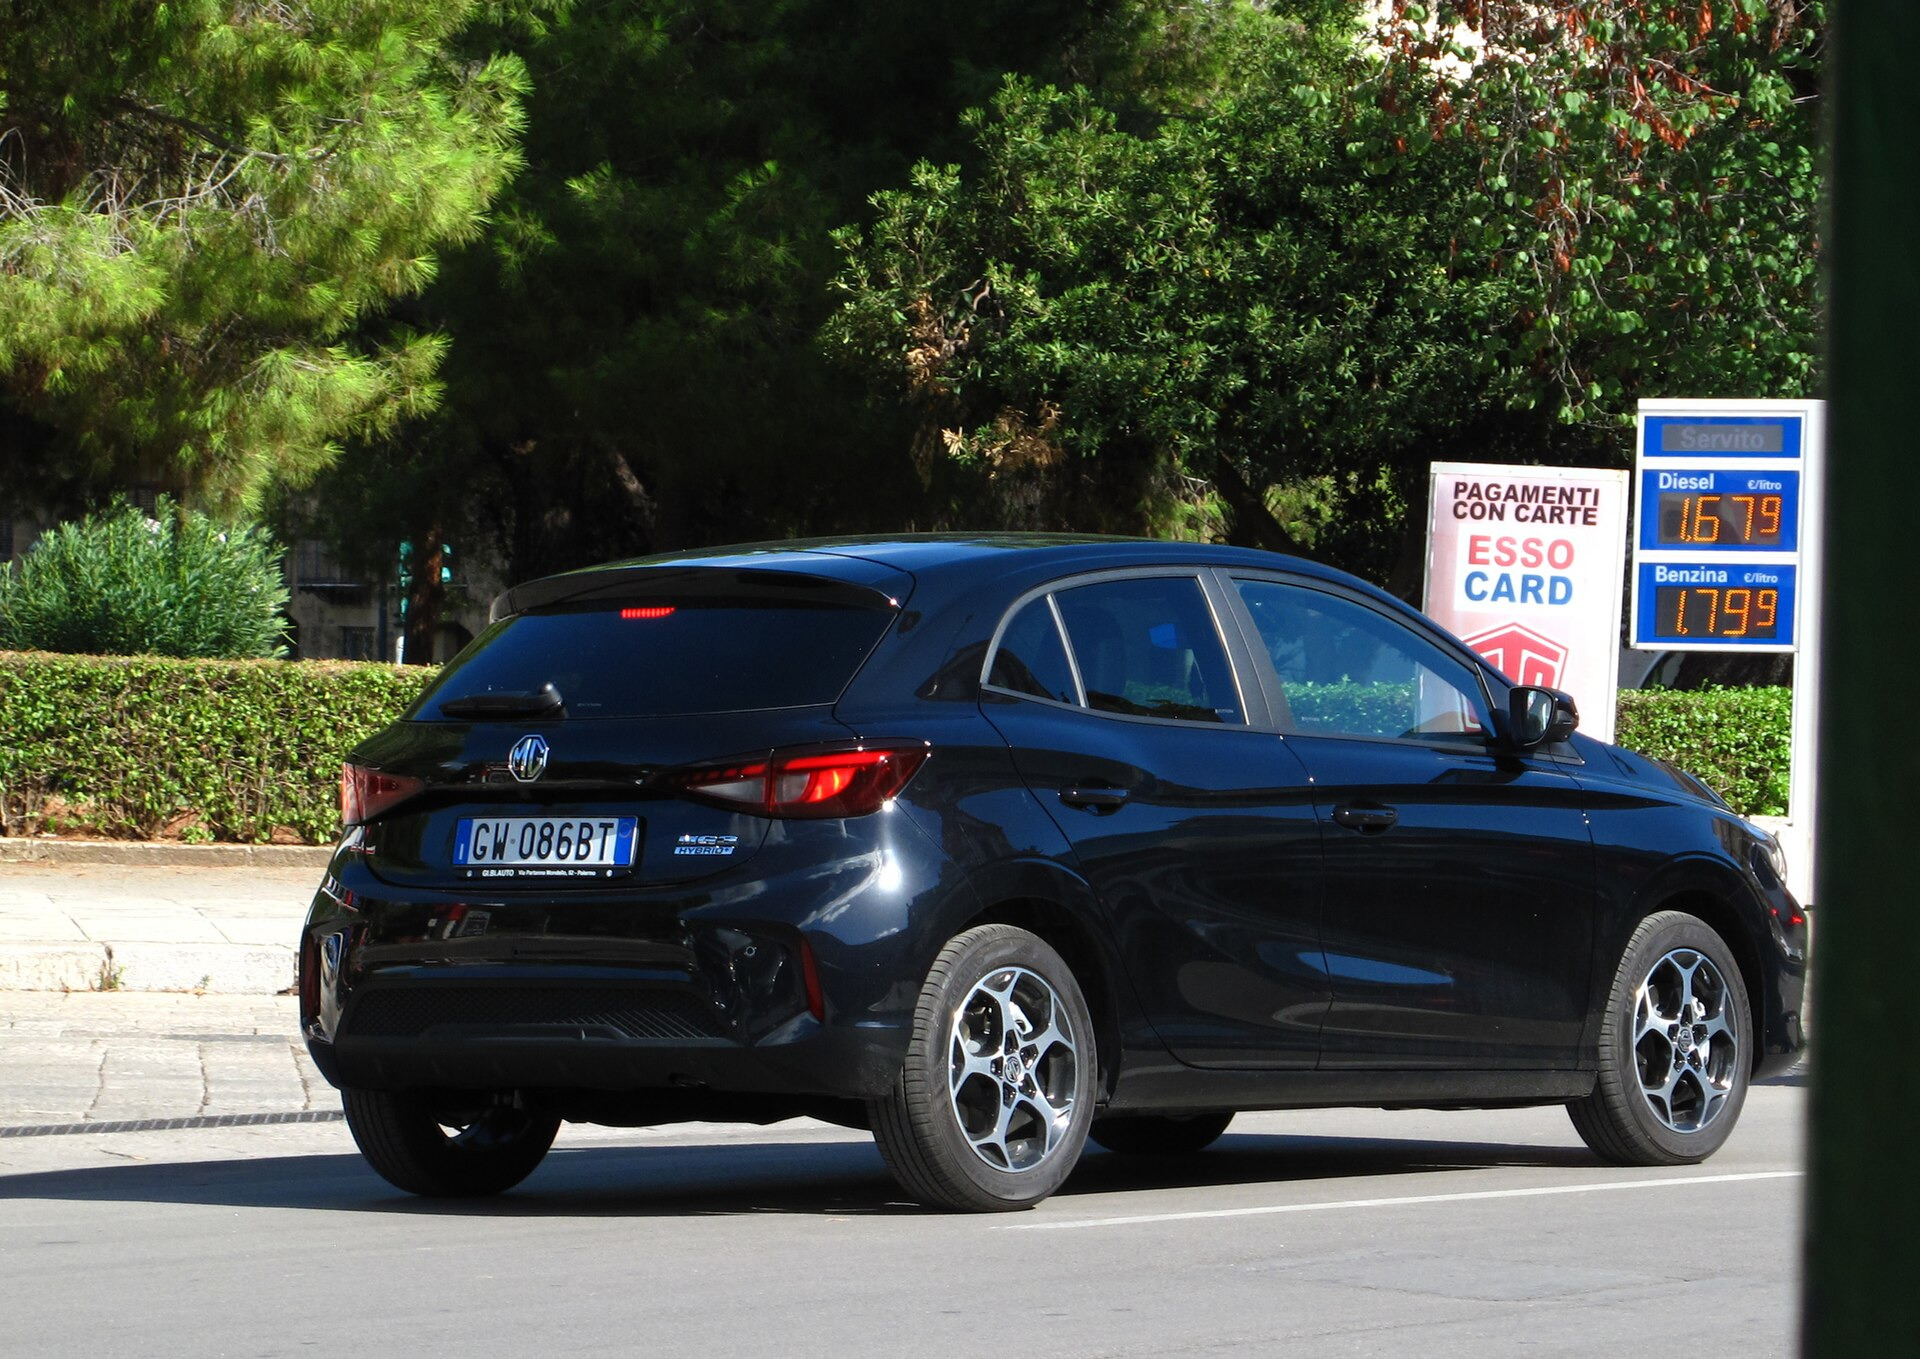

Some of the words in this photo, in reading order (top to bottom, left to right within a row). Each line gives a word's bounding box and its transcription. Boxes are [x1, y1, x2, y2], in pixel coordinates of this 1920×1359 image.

[1681, 427, 1765, 449] Servito
[1453, 481, 1600, 506] PAGAMENTI
[1659, 473, 1714, 490] Diesel
[1748, 479, 1782, 491] €/litro
[1453, 501, 1505, 521] CON
[1514, 504, 1598, 526] CARTE
[1468, 535, 1574, 569] ESSO
[1655, 566, 1728, 583] Benzina
[1744, 573, 1778, 584] €/litro
[1464, 571, 1573, 605] CARD
[511, 736, 547, 780] MG
